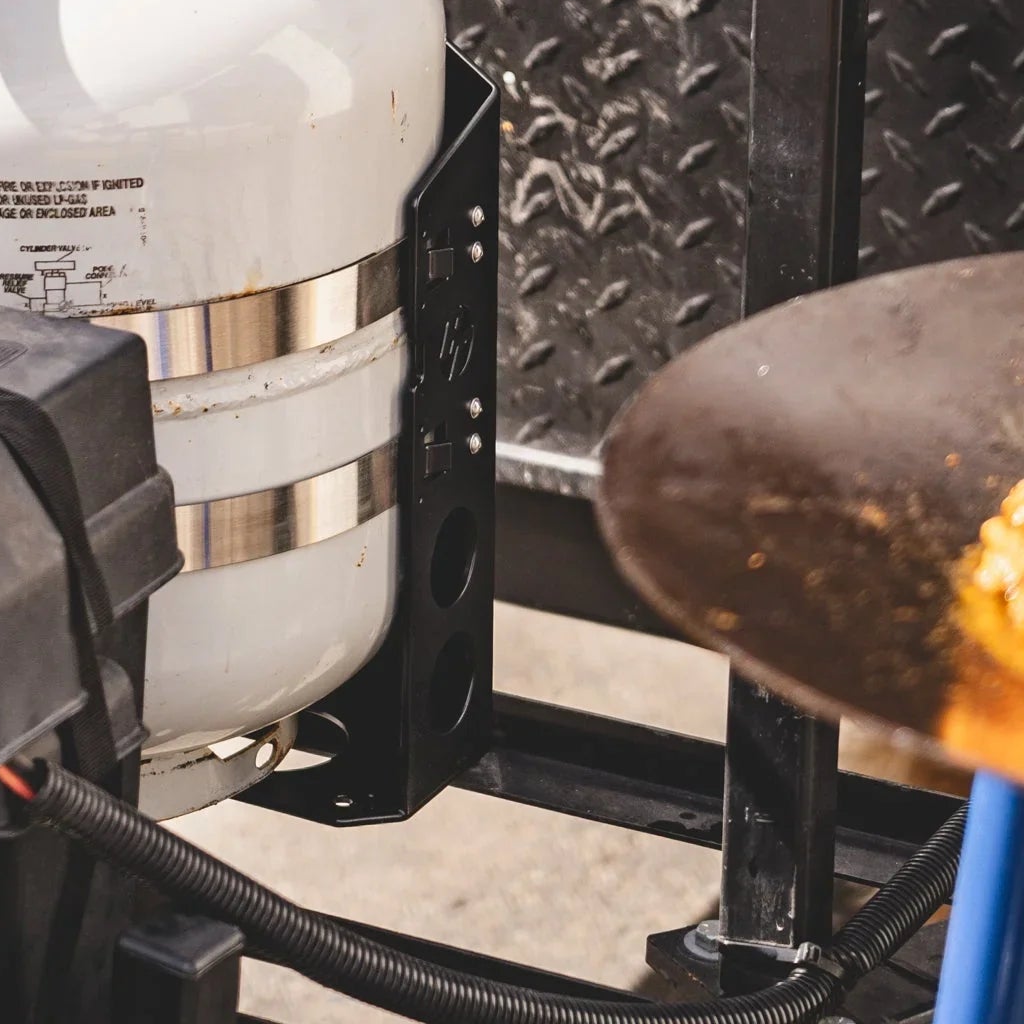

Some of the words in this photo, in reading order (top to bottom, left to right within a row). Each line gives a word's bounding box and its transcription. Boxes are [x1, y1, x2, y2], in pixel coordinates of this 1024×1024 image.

[20, 181, 35, 192] OR
[91, 179, 101, 191] IF
[102, 177, 144, 191] IGNITED
[12, 193, 51, 206] UNUSED
[53, 193, 88, 206] LP-GAS
[19, 207, 34, 219] OR
[36, 207, 86, 219] ENCLOSED
[88, 206, 116, 218] AREA
[20, 245, 57, 253] CYLINDER
